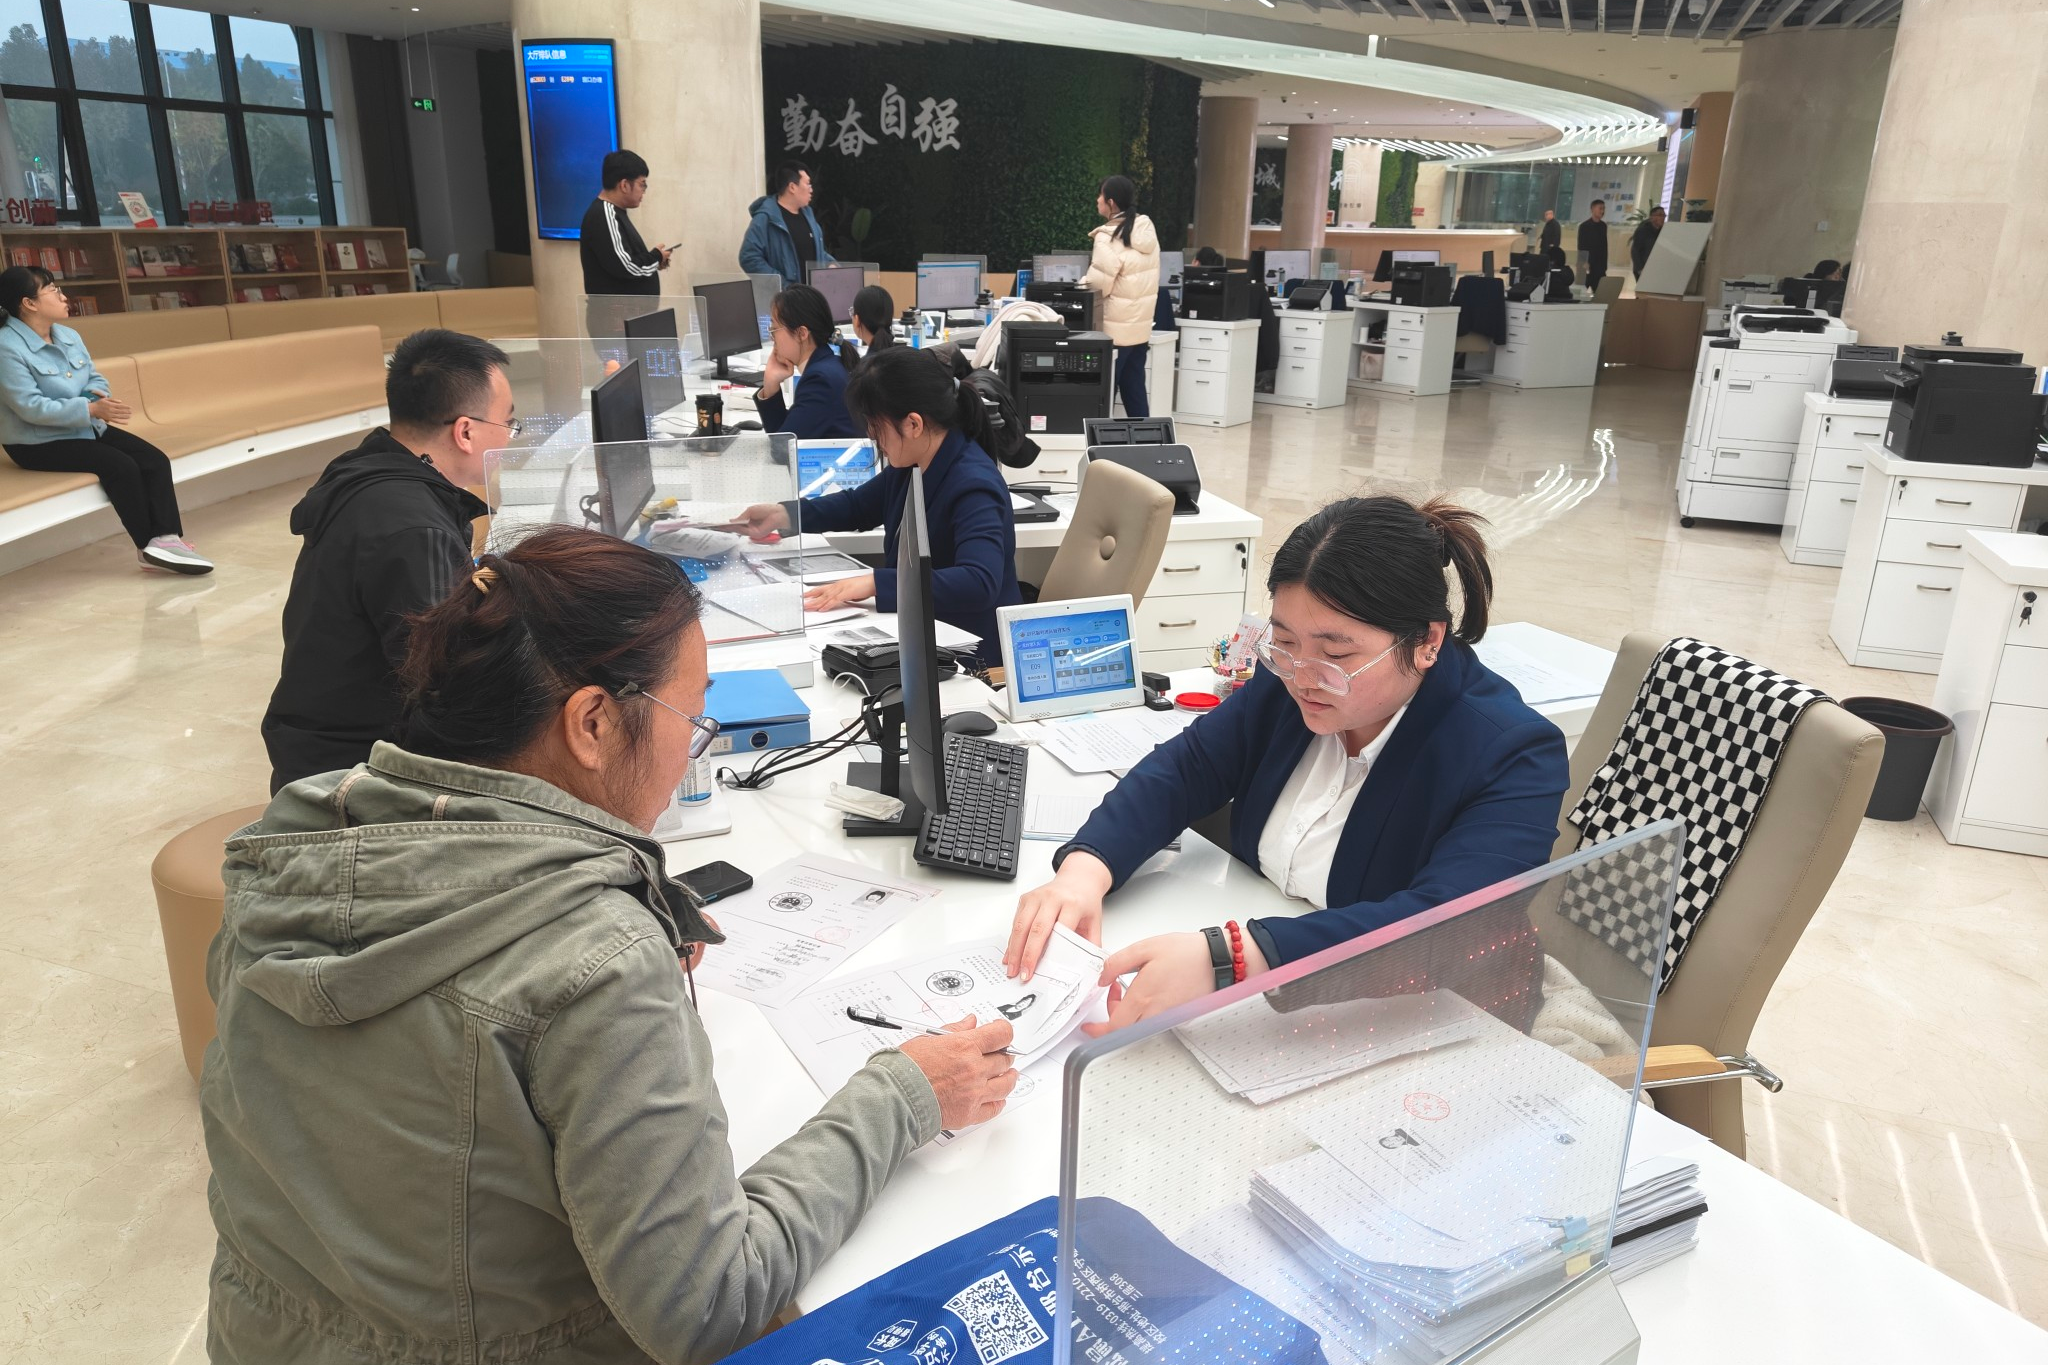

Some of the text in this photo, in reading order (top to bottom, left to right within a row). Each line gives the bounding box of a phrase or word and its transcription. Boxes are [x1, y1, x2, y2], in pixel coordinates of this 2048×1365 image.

[781, 83, 961, 157] 勤奋自强
[0, 197, 57, 226] 创新
[1108, 1272, 1144, 1302] 三层308
